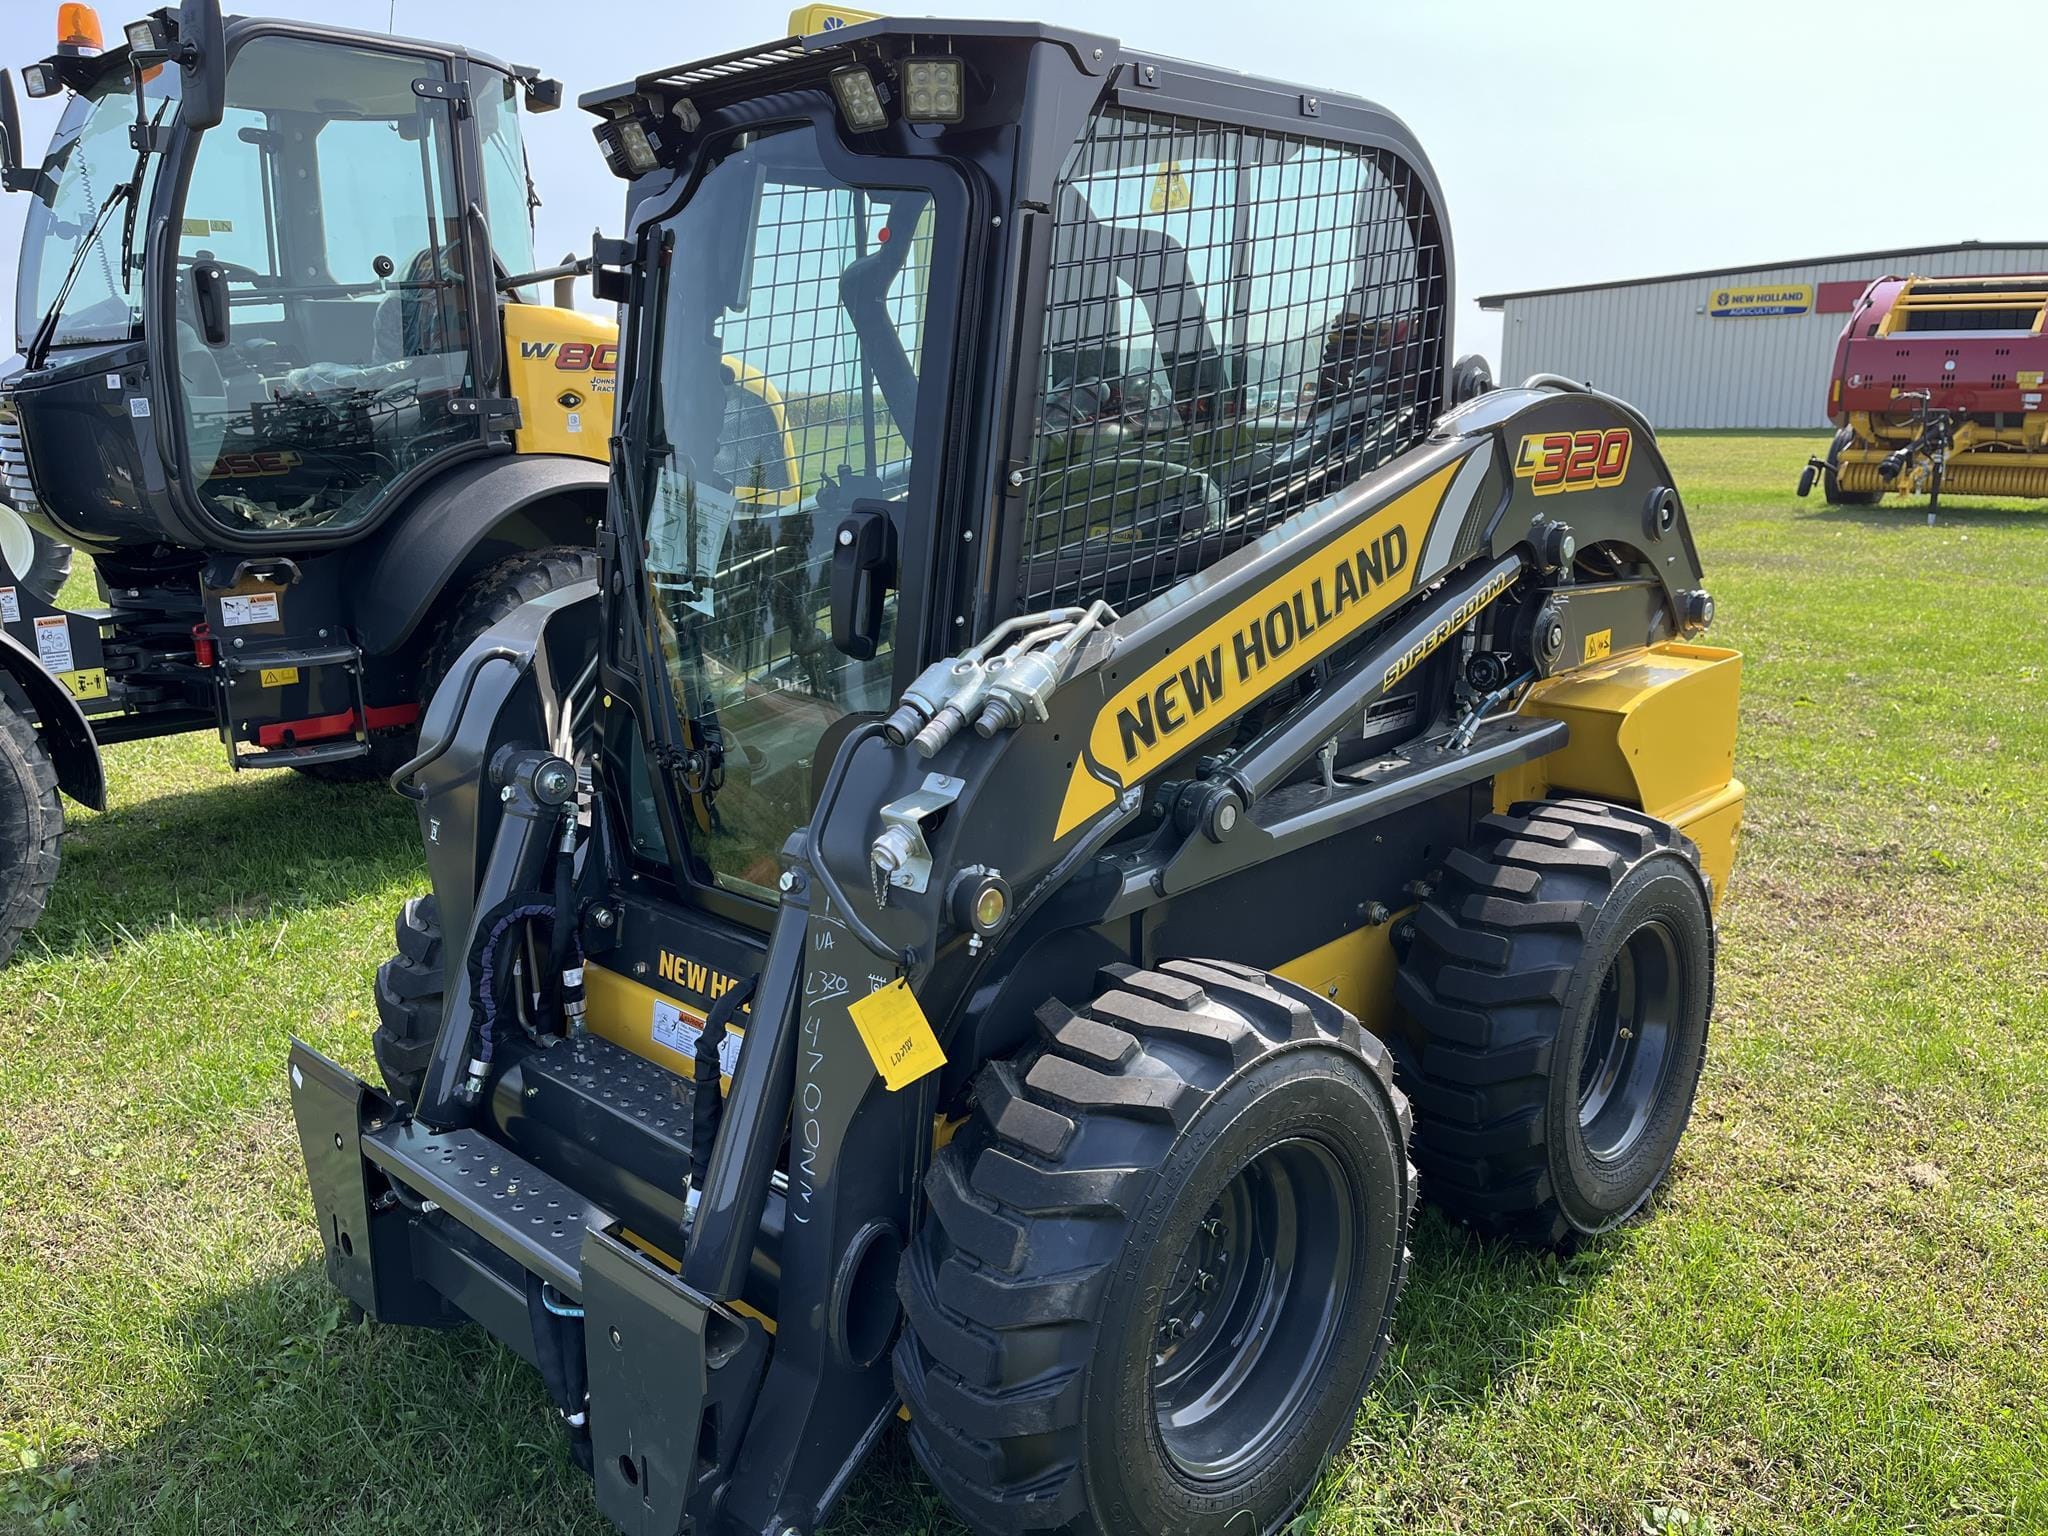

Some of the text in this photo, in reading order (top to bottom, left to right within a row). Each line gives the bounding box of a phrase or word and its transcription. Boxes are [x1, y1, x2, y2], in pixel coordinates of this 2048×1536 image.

[1729, 306, 1785, 316] AGRICULTURE
[1731, 292, 1803, 304] NEW HOLLAND
[1516, 429, 1631, 490] L320
[1115, 523, 1408, 764] NEW HOLLAND
[659, 950, 707, 994] NEW
[805, 970, 849, 995] L320
